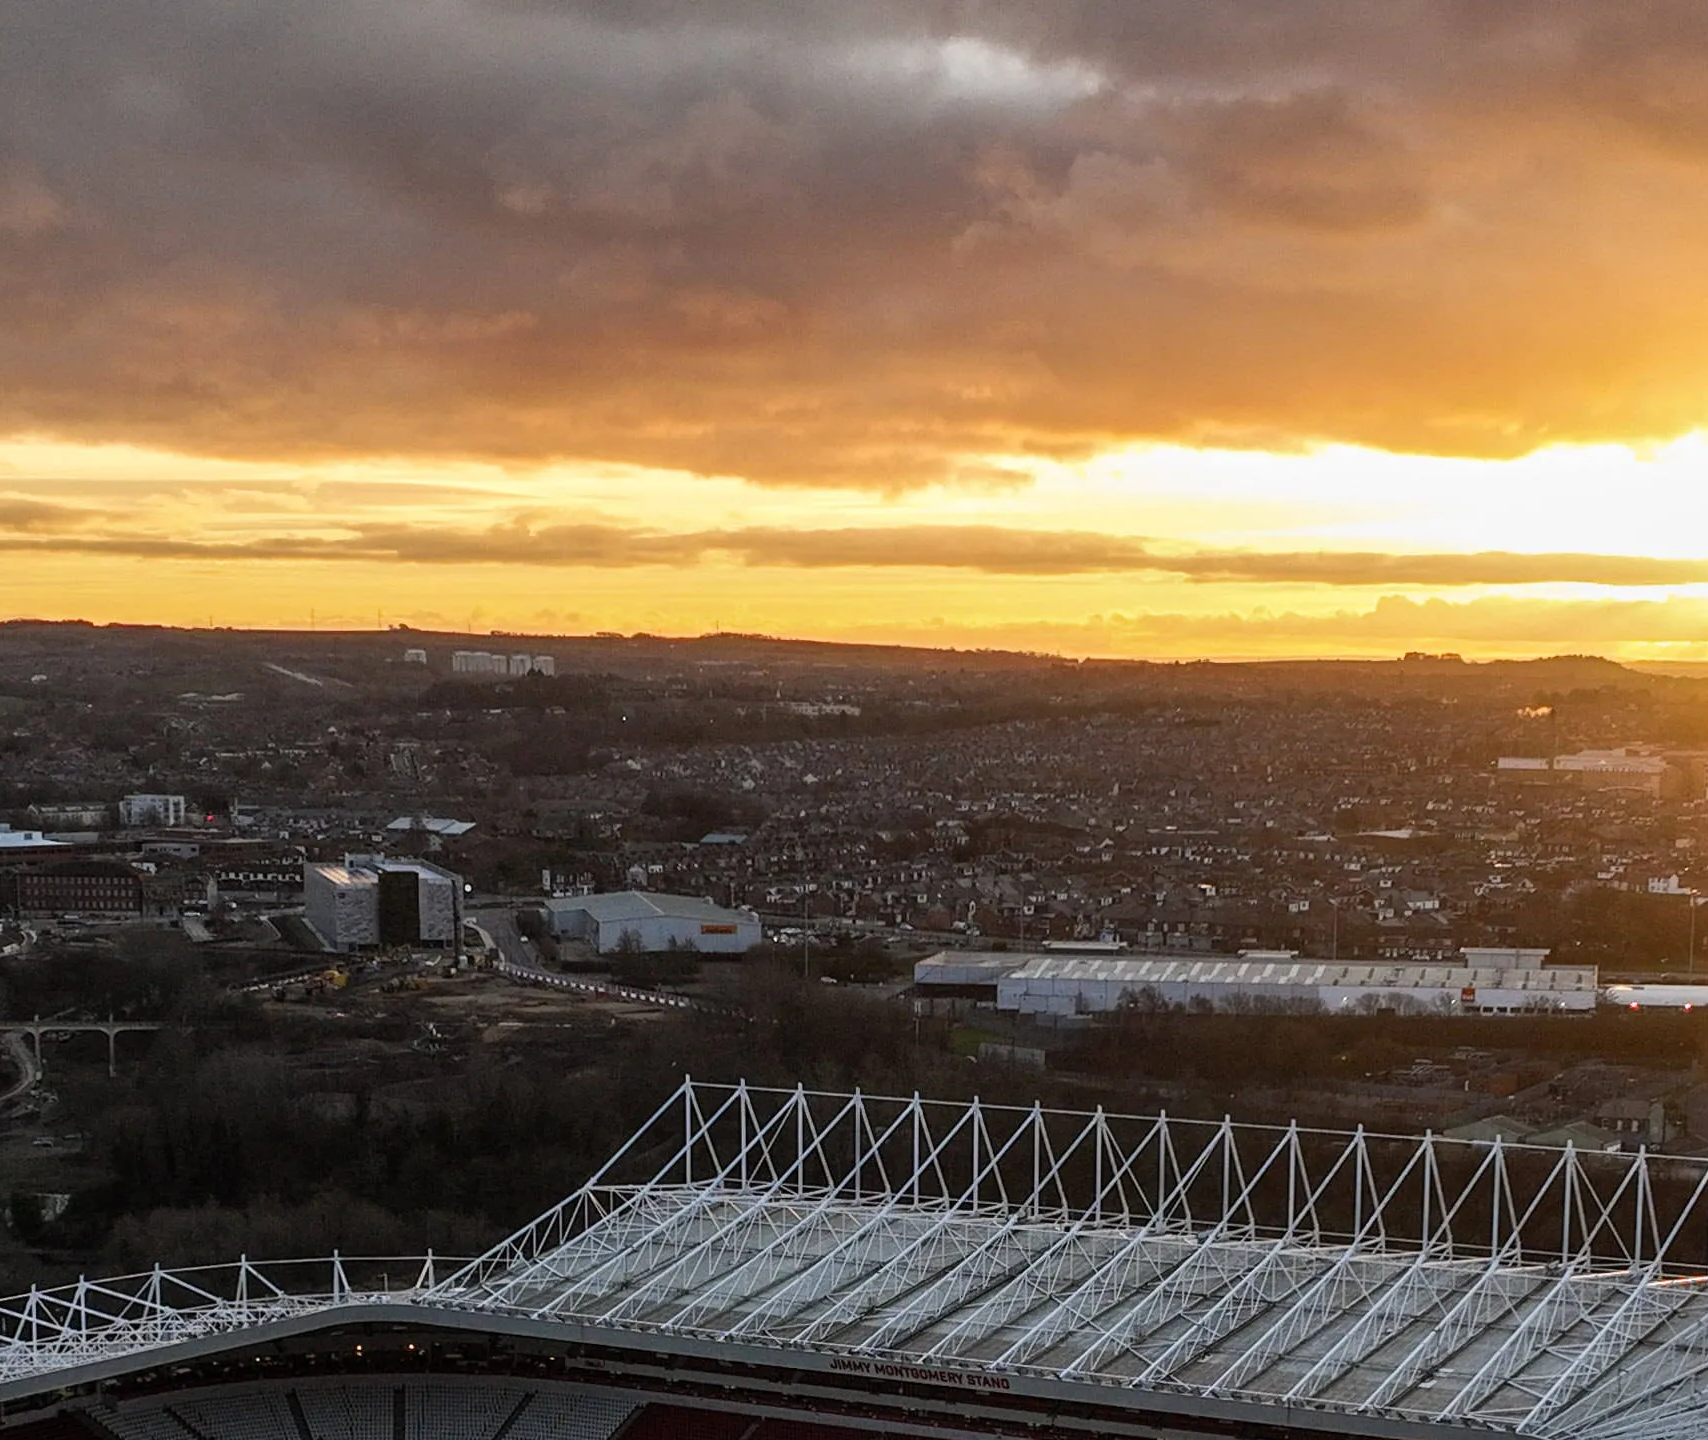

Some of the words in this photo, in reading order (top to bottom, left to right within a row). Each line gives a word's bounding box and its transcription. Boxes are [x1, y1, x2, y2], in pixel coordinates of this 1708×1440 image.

[830, 1358, 871, 1373] JIMMY
[874, 1364, 963, 1386] MONTGOMERY
[968, 1375, 1010, 1390] STAND
